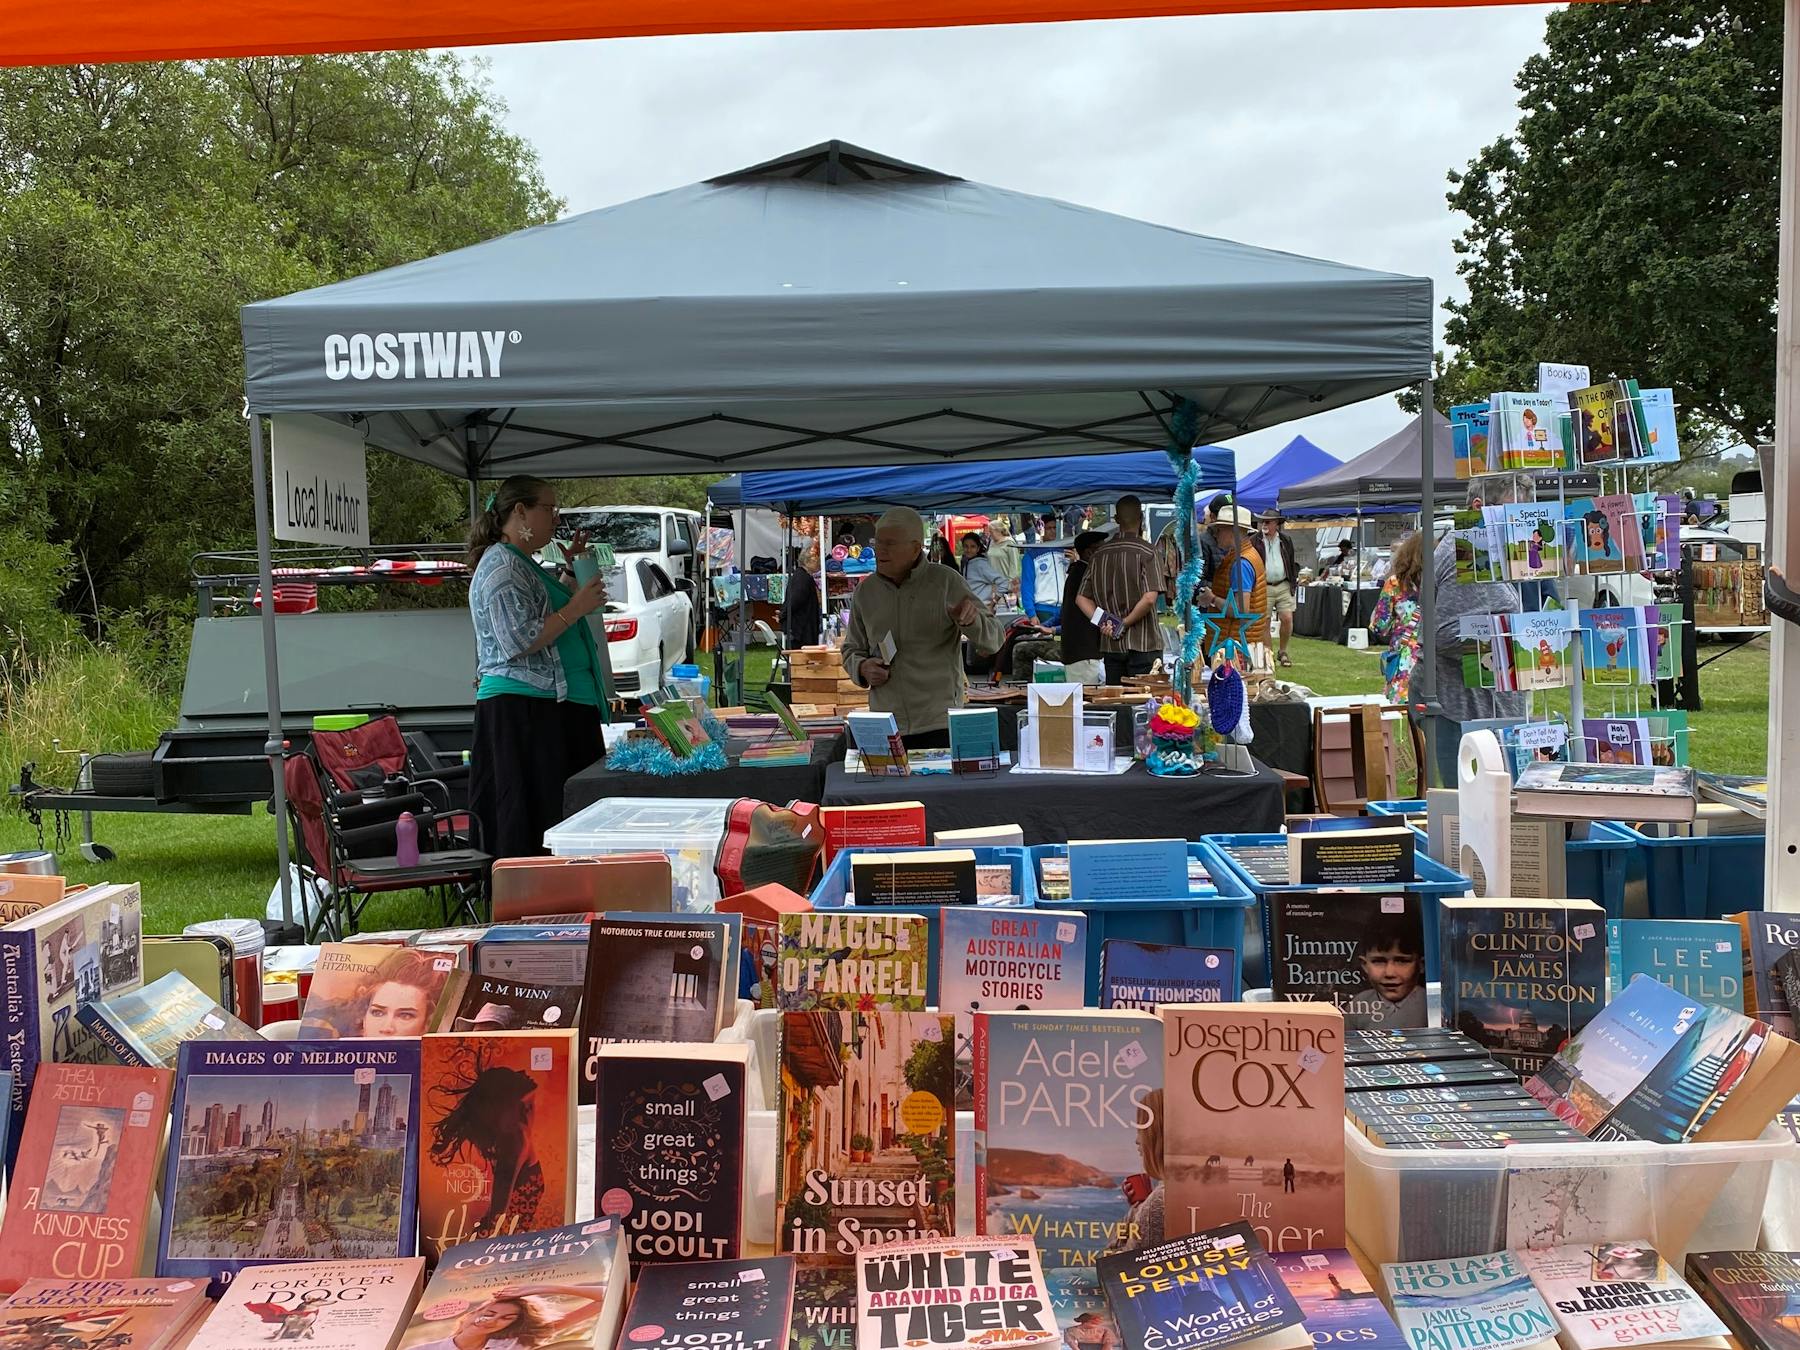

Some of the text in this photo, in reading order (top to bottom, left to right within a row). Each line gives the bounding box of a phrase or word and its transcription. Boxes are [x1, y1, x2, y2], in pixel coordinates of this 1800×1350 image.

[1547, 366, 1572, 379] Books
[286, 470, 360, 535] Local Author
[1520, 509, 1549, 519] Special
[1531, 617, 1559, 628] Sparky
[991, 919, 1039, 938] GREAT
[1503, 912, 1552, 929] BILL
[601, 927, 716, 939] NOTORIOUS TRUE CRIME STORIES
[800, 915, 911, 950] MAGGIE
[1471, 933, 1583, 953] CLINTON
[324, 952, 351, 963] PETER
[966, 939, 1063, 961] AUSTRALIAN
[1283, 934, 1359, 962] Jimmy
[1654, 948, 1713, 968] LEE
[321, 962, 381, 975] FITZPATRICK
[783, 957, 926, 996] O'FARRELL
[966, 959, 1062, 981] MOTORCYCLE
[1287, 963, 1361, 985] Barnes
[1491, 960, 1564, 982] JAMES
[3, 944, 25, 1023] Australia's
[514, 987, 551, 1000] WINN
[981, 980, 1043, 1001] STORIES
[1111, 985, 1221, 1002] TONY THOMPSON
[1460, 981, 1597, 1004] PATTERSON
[1012, 1023, 1141, 1034] THE SUNDAY TIMES BESTSELLER
[1629, 1008, 1664, 1035] dollar
[91, 1019, 126, 1055] IMAGES OF
[1169, 1016, 1336, 1060] Josephine
[205, 1051, 397, 1065] IMAGES OF MELBOURNE
[1016, 1038, 1135, 1079] Adele
[1597, 1027, 1649, 1071] dreaming
[57, 1069, 95, 1084] THEA
[52, 1085, 105, 1101] ASTLEY
[978, 1073, 986, 1123] PARKS
[645, 1100, 695, 1116] small
[999, 1081, 1155, 1130] PARKS
[643, 1133, 695, 1151] great
[639, 1164, 698, 1186] things
[446, 1180, 491, 1194] NIGHT
[804, 1168, 932, 1207] Sunset
[24, 1187, 39, 1210] A
[1237, 1193, 1272, 1219] The
[32, 1213, 130, 1238] KINDNESS
[631, 1210, 703, 1232] JODI
[1011, 1214, 1142, 1240] WHATEVER
[485, 1232, 576, 1255] Home to the
[791, 1217, 826, 1254] in
[1143, 1234, 1208, 1255] NUMBER ONE
[52, 1241, 125, 1278] CUP
[454, 1238, 600, 1270] country
[1135, 1237, 1220, 1262] NEW YORK TIMES
[1148, 1245, 1211, 1264] BESTSELLER
[1731, 1252, 1794, 1267] KERRY
[864, 1250, 1034, 1292] WHITE
[1119, 1245, 1249, 1283] LOUISE
[1389, 1264, 1441, 1277] THE
[1450, 1253, 1515, 1272] LAKE
[251, 1276, 396, 1291] FOREVER
[687, 1279, 741, 1290] small
[1125, 1257, 1250, 1298] PENNY
[1394, 1264, 1520, 1291] HOUSE
[9, 1296, 104, 1305] COLONY
[38, 1288, 159, 1297] PECULIAR
[265, 1287, 368, 1304] DOG
[682, 1294, 740, 1306] great
[870, 1285, 1037, 1308] ARAVIND ADIGA
[1556, 1288, 1693, 1314] SLAUGHTER
[1576, 1282, 1652, 1299] KARIN
[675, 1311, 741, 1321] things
[867, 1300, 1044, 1349] TIGER
[1144, 1294, 1276, 1339] A World of
[1422, 1308, 1472, 1328] JAMES
[1589, 1308, 1681, 1331] pretty
[661, 1331, 744, 1345] JODI
[1144, 1307, 1284, 1350] Curiosities
[1410, 1306, 1552, 1350] PATTERSON
[1613, 1321, 1682, 1343] girls
